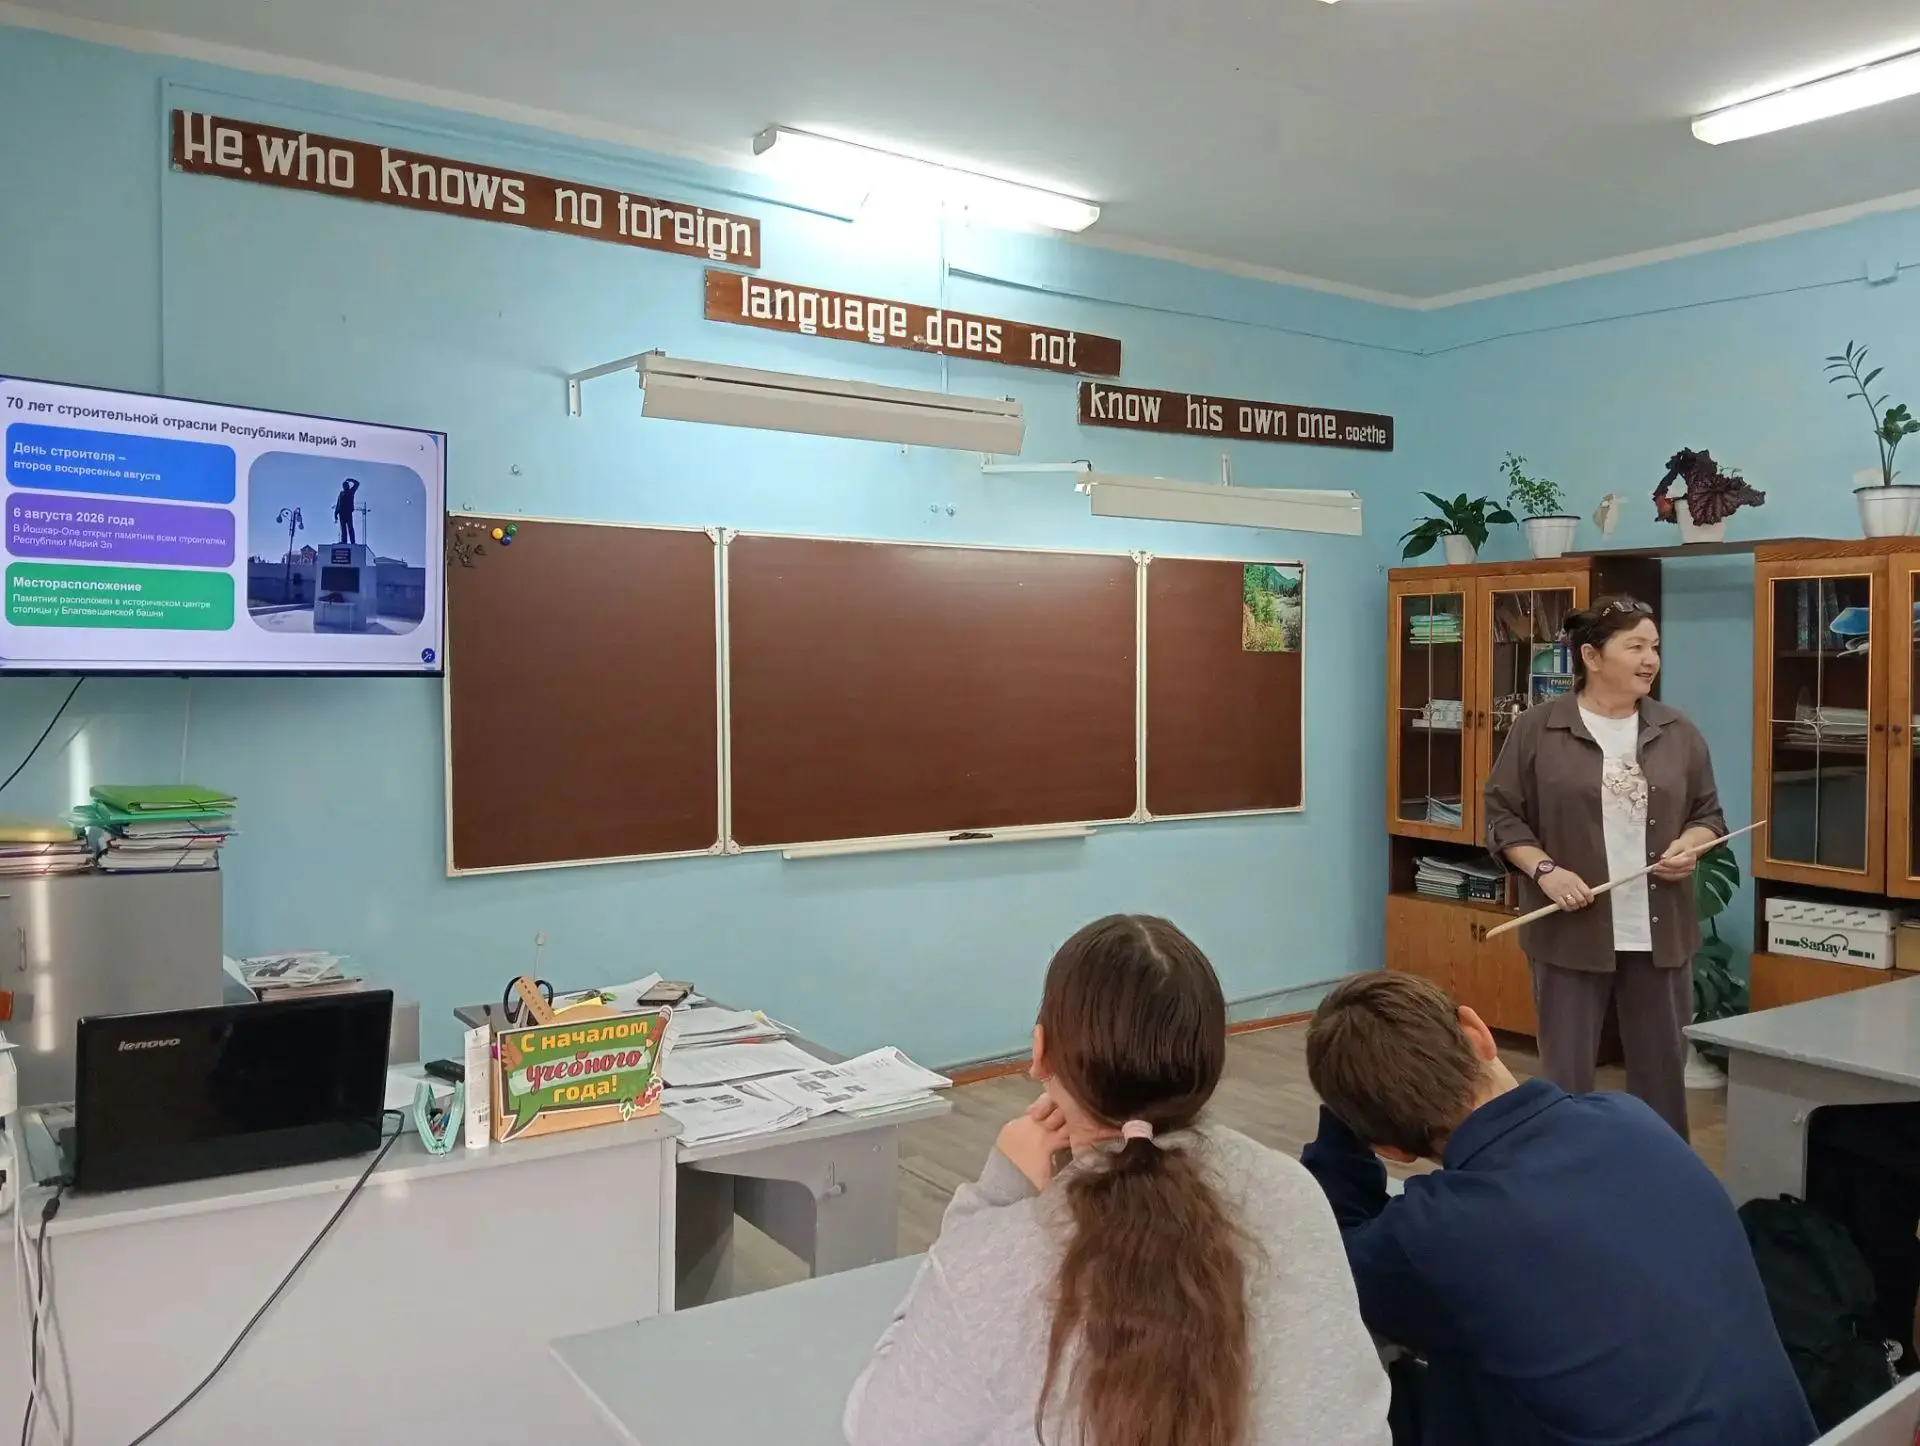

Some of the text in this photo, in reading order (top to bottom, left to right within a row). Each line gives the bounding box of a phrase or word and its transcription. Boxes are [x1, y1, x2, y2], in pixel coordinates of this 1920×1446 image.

[256, 132, 354, 189] who
[380, 147, 525, 215] knows
[554, 187, 603, 229] no
[617, 194, 753, 261] foreign
[926, 309, 1002, 354] does
[1030, 331, 1077, 367] not
[1090, 383, 1161, 423] know
[1186, 394, 1223, 432] his
[1239, 406, 1287, 437] own
[1297, 412, 1343, 440] one.
[6, 396, 357, 449] 70 лет строительной отрасли Республики Марий Эл
[13, 441, 47, 456] День
[50, 447, 116, 462] строителя
[13, 460, 161, 482] второе воскресенье августа
[13, 507, 135, 526] 6 августа 2026 года
[13, 523, 20, 532] В
[22, 523, 80, 537] Йошкар-Оле
[82, 529, 113, 540] открыт
[114, 531, 154, 541] памятник
[13, 535, 113, 549] Республики Марий Эл
[13, 576, 142, 592] Месторасположение
[12, 593, 58, 604] Памятник
[60, 595, 113, 606] расположен
[122, 599, 180, 610] историческом
[182, 601, 211, 610] центре
[12, 606, 52, 616] столицы
[136, 608, 164, 617] башни
[1800, 936, 1841, 957] Sanay
[117, 1038, 181, 1051] lenovo
[520, 1020, 648, 1053] С началом
[526, 1049, 643, 1095] учебного
[553, 1074, 618, 1103] года!
